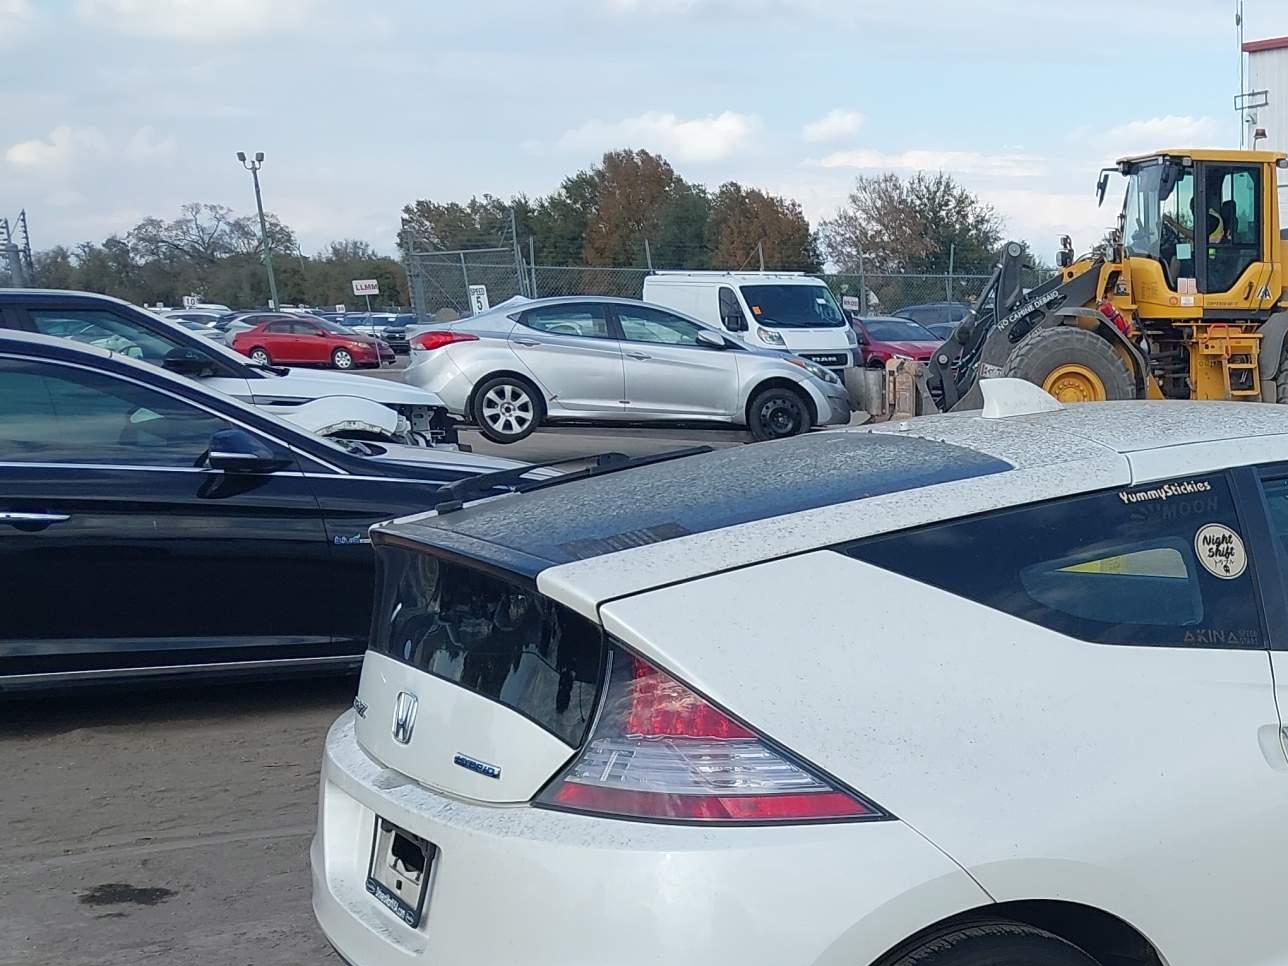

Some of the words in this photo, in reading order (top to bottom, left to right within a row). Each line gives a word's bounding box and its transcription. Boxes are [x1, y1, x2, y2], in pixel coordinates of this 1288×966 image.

[476, 296, 483, 311] 5
[997, 319, 1009, 332] NO
[1119, 481, 1211, 504] YummyStickies
[1203, 533, 1233, 550] Night
[1207, 545, 1235, 560] Shift
[1184, 629, 1239, 644] AKINA
